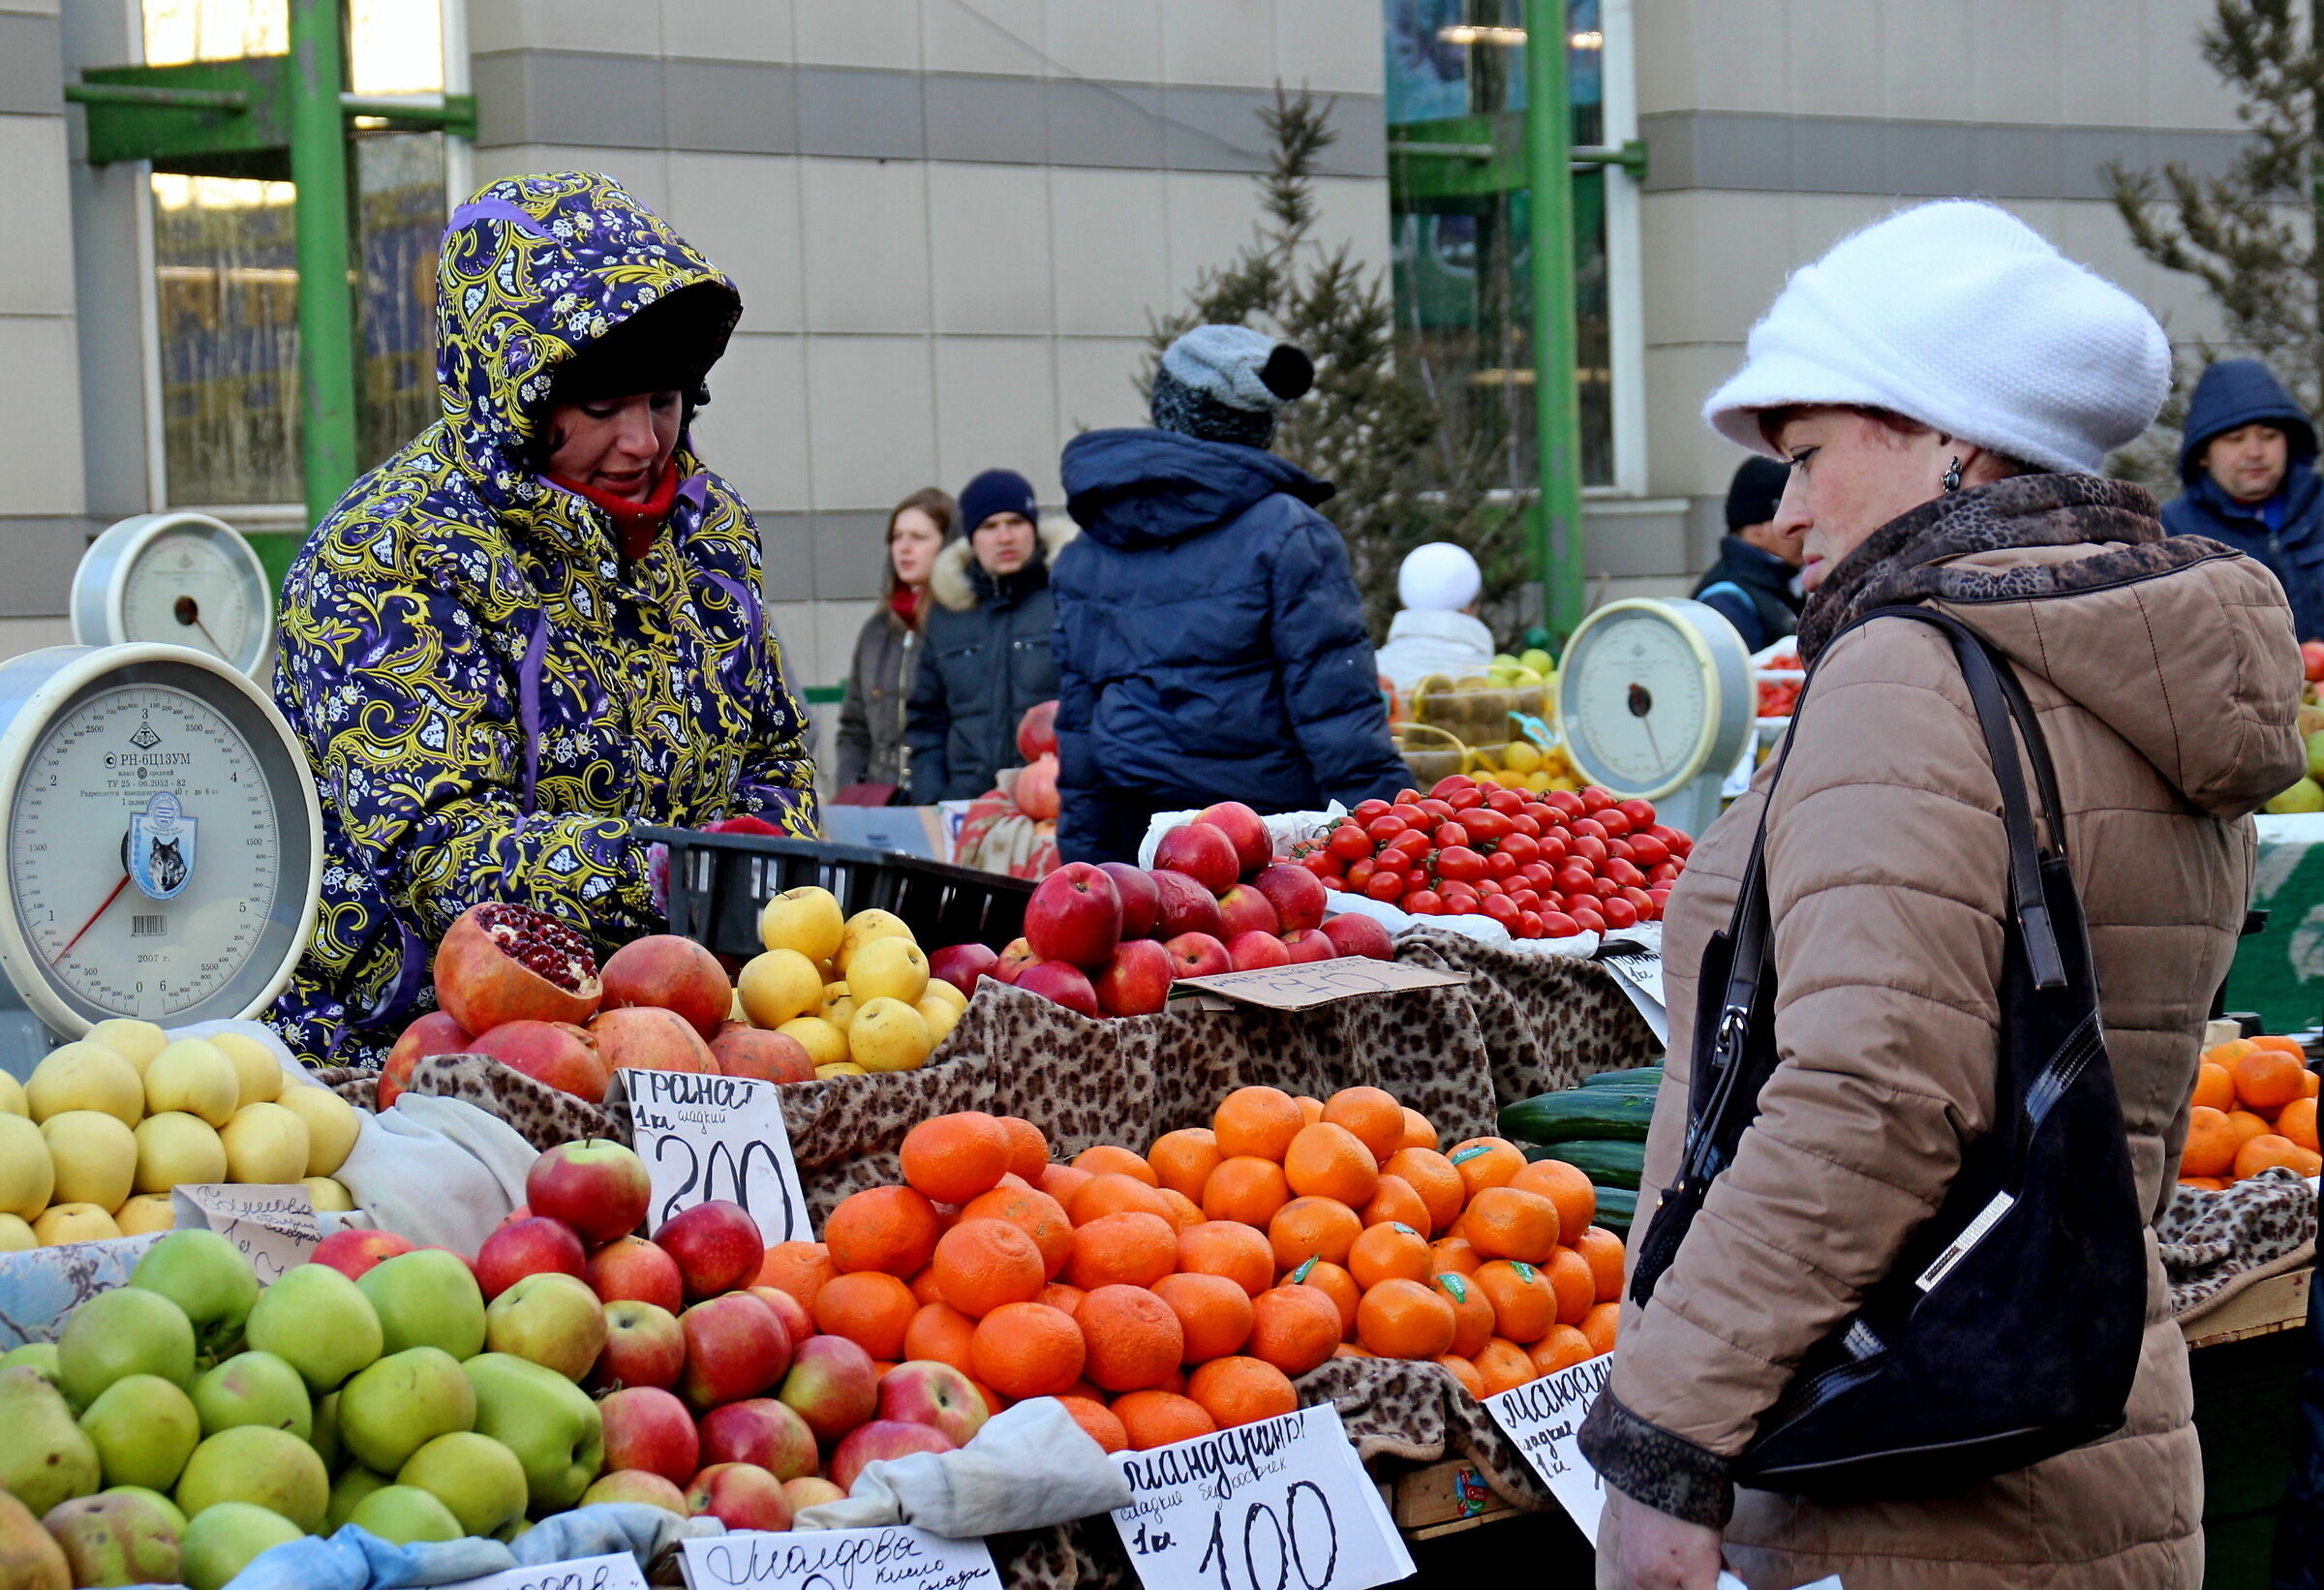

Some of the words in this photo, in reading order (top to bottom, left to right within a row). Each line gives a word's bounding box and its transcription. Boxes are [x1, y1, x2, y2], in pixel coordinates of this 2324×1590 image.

[141, 708, 148, 719] 3
[120, 752, 192, 767] РН-6Ц13УМ
[50, 775, 57, 786] 2
[230, 771, 237, 782] 4
[121, 779, 131, 787] 25
[176, 779, 187, 787] 82
[239, 902, 247, 913] 5
[49, 910, 54, 921] 1
[138, 954, 159, 963] 2007
[136, 980, 143, 993] 0
[160, 980, 167, 991] 6
[678, 1108, 726, 1134] сладкий
[655, 1134, 794, 1242] 200
[1120, 1490, 1183, 1524] сладкие
[1198, 1480, 1337, 1590] 100
